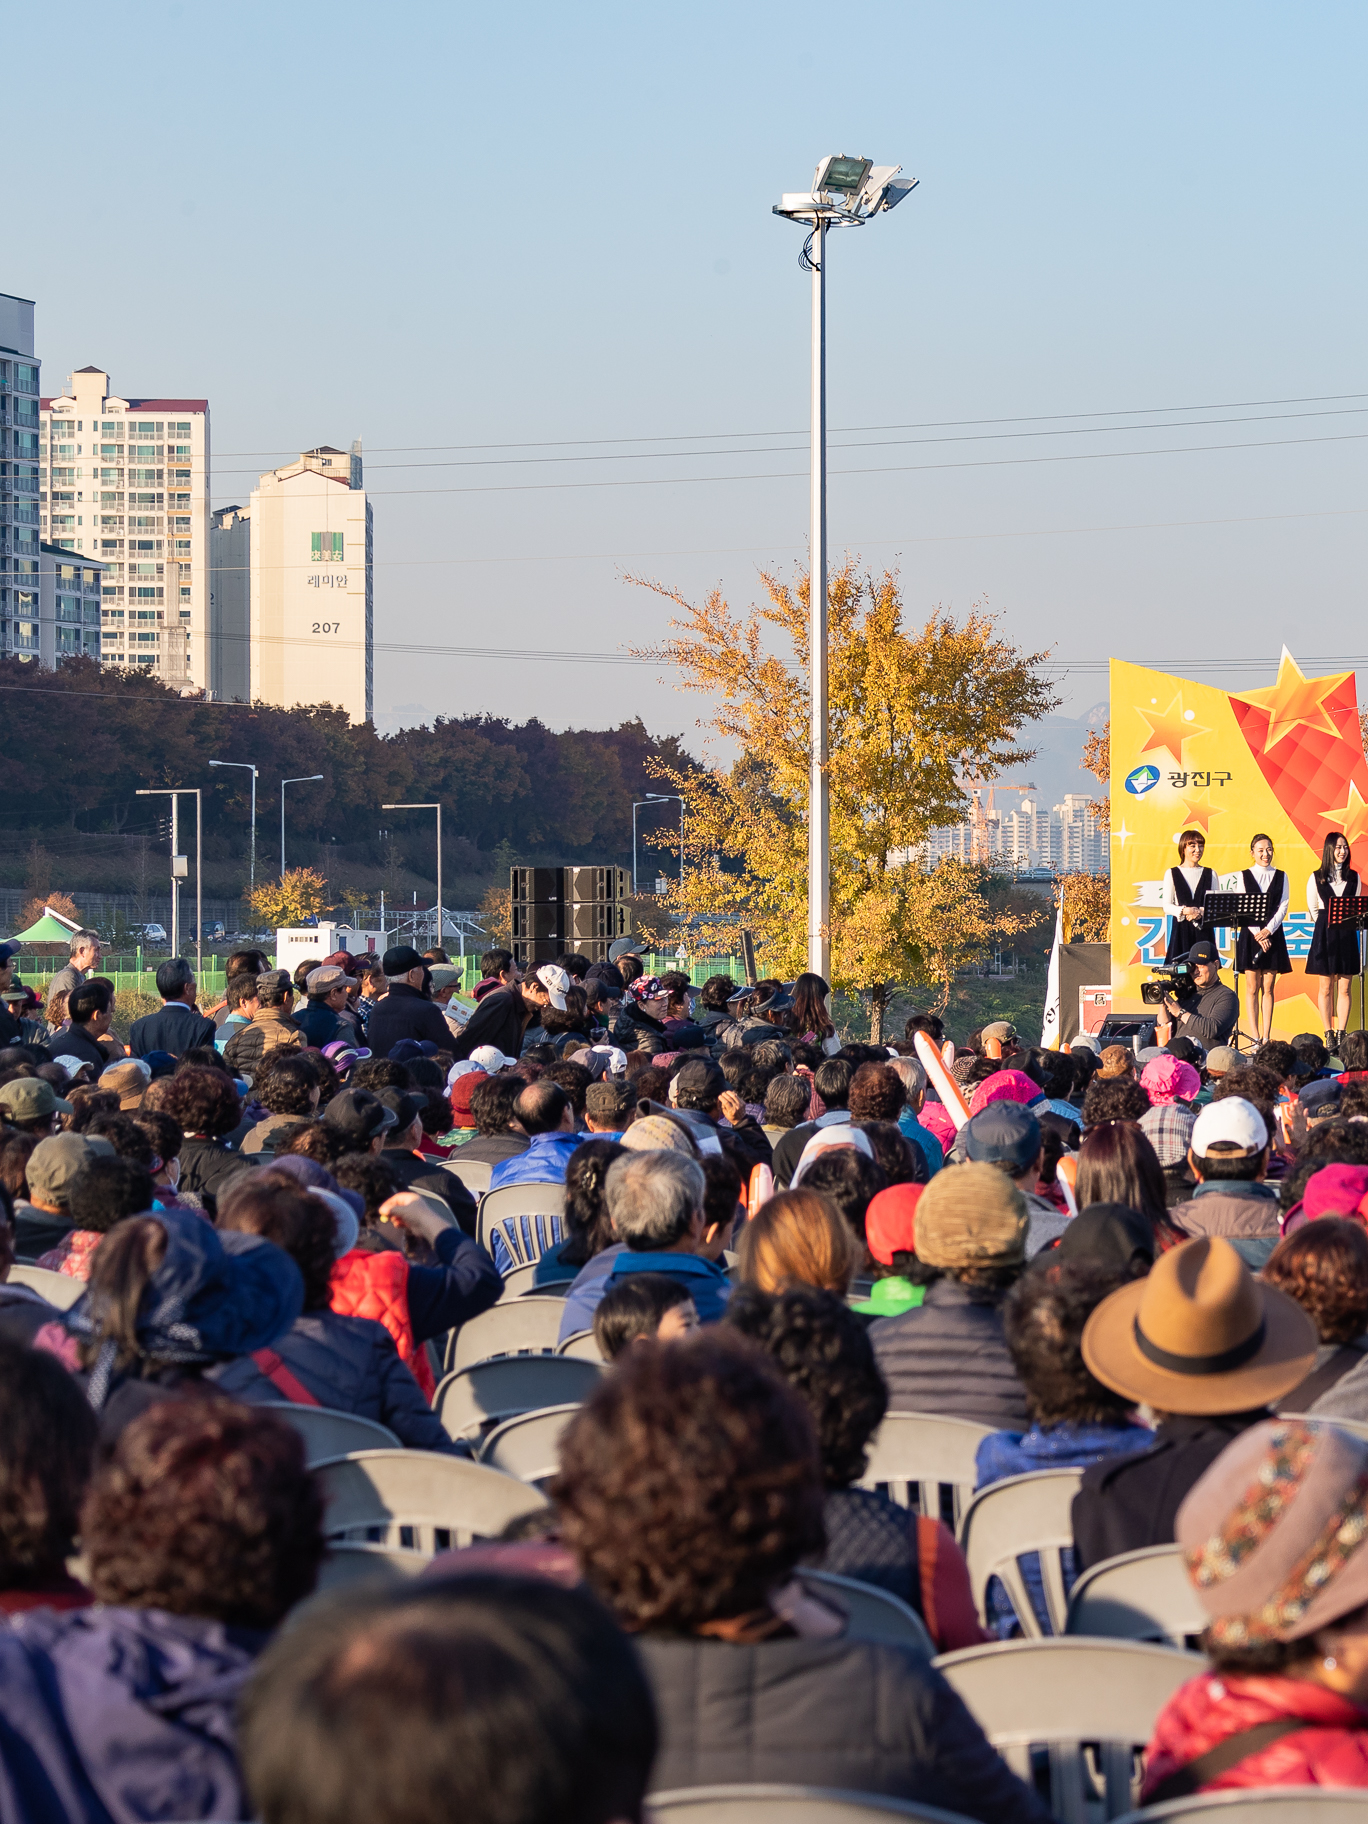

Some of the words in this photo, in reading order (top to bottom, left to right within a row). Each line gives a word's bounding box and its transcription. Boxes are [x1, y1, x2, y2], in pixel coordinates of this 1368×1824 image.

[307, 574, 348, 588] 래미안
[311, 622, 341, 634] 207
[1167, 771, 1233, 788] 광진구
